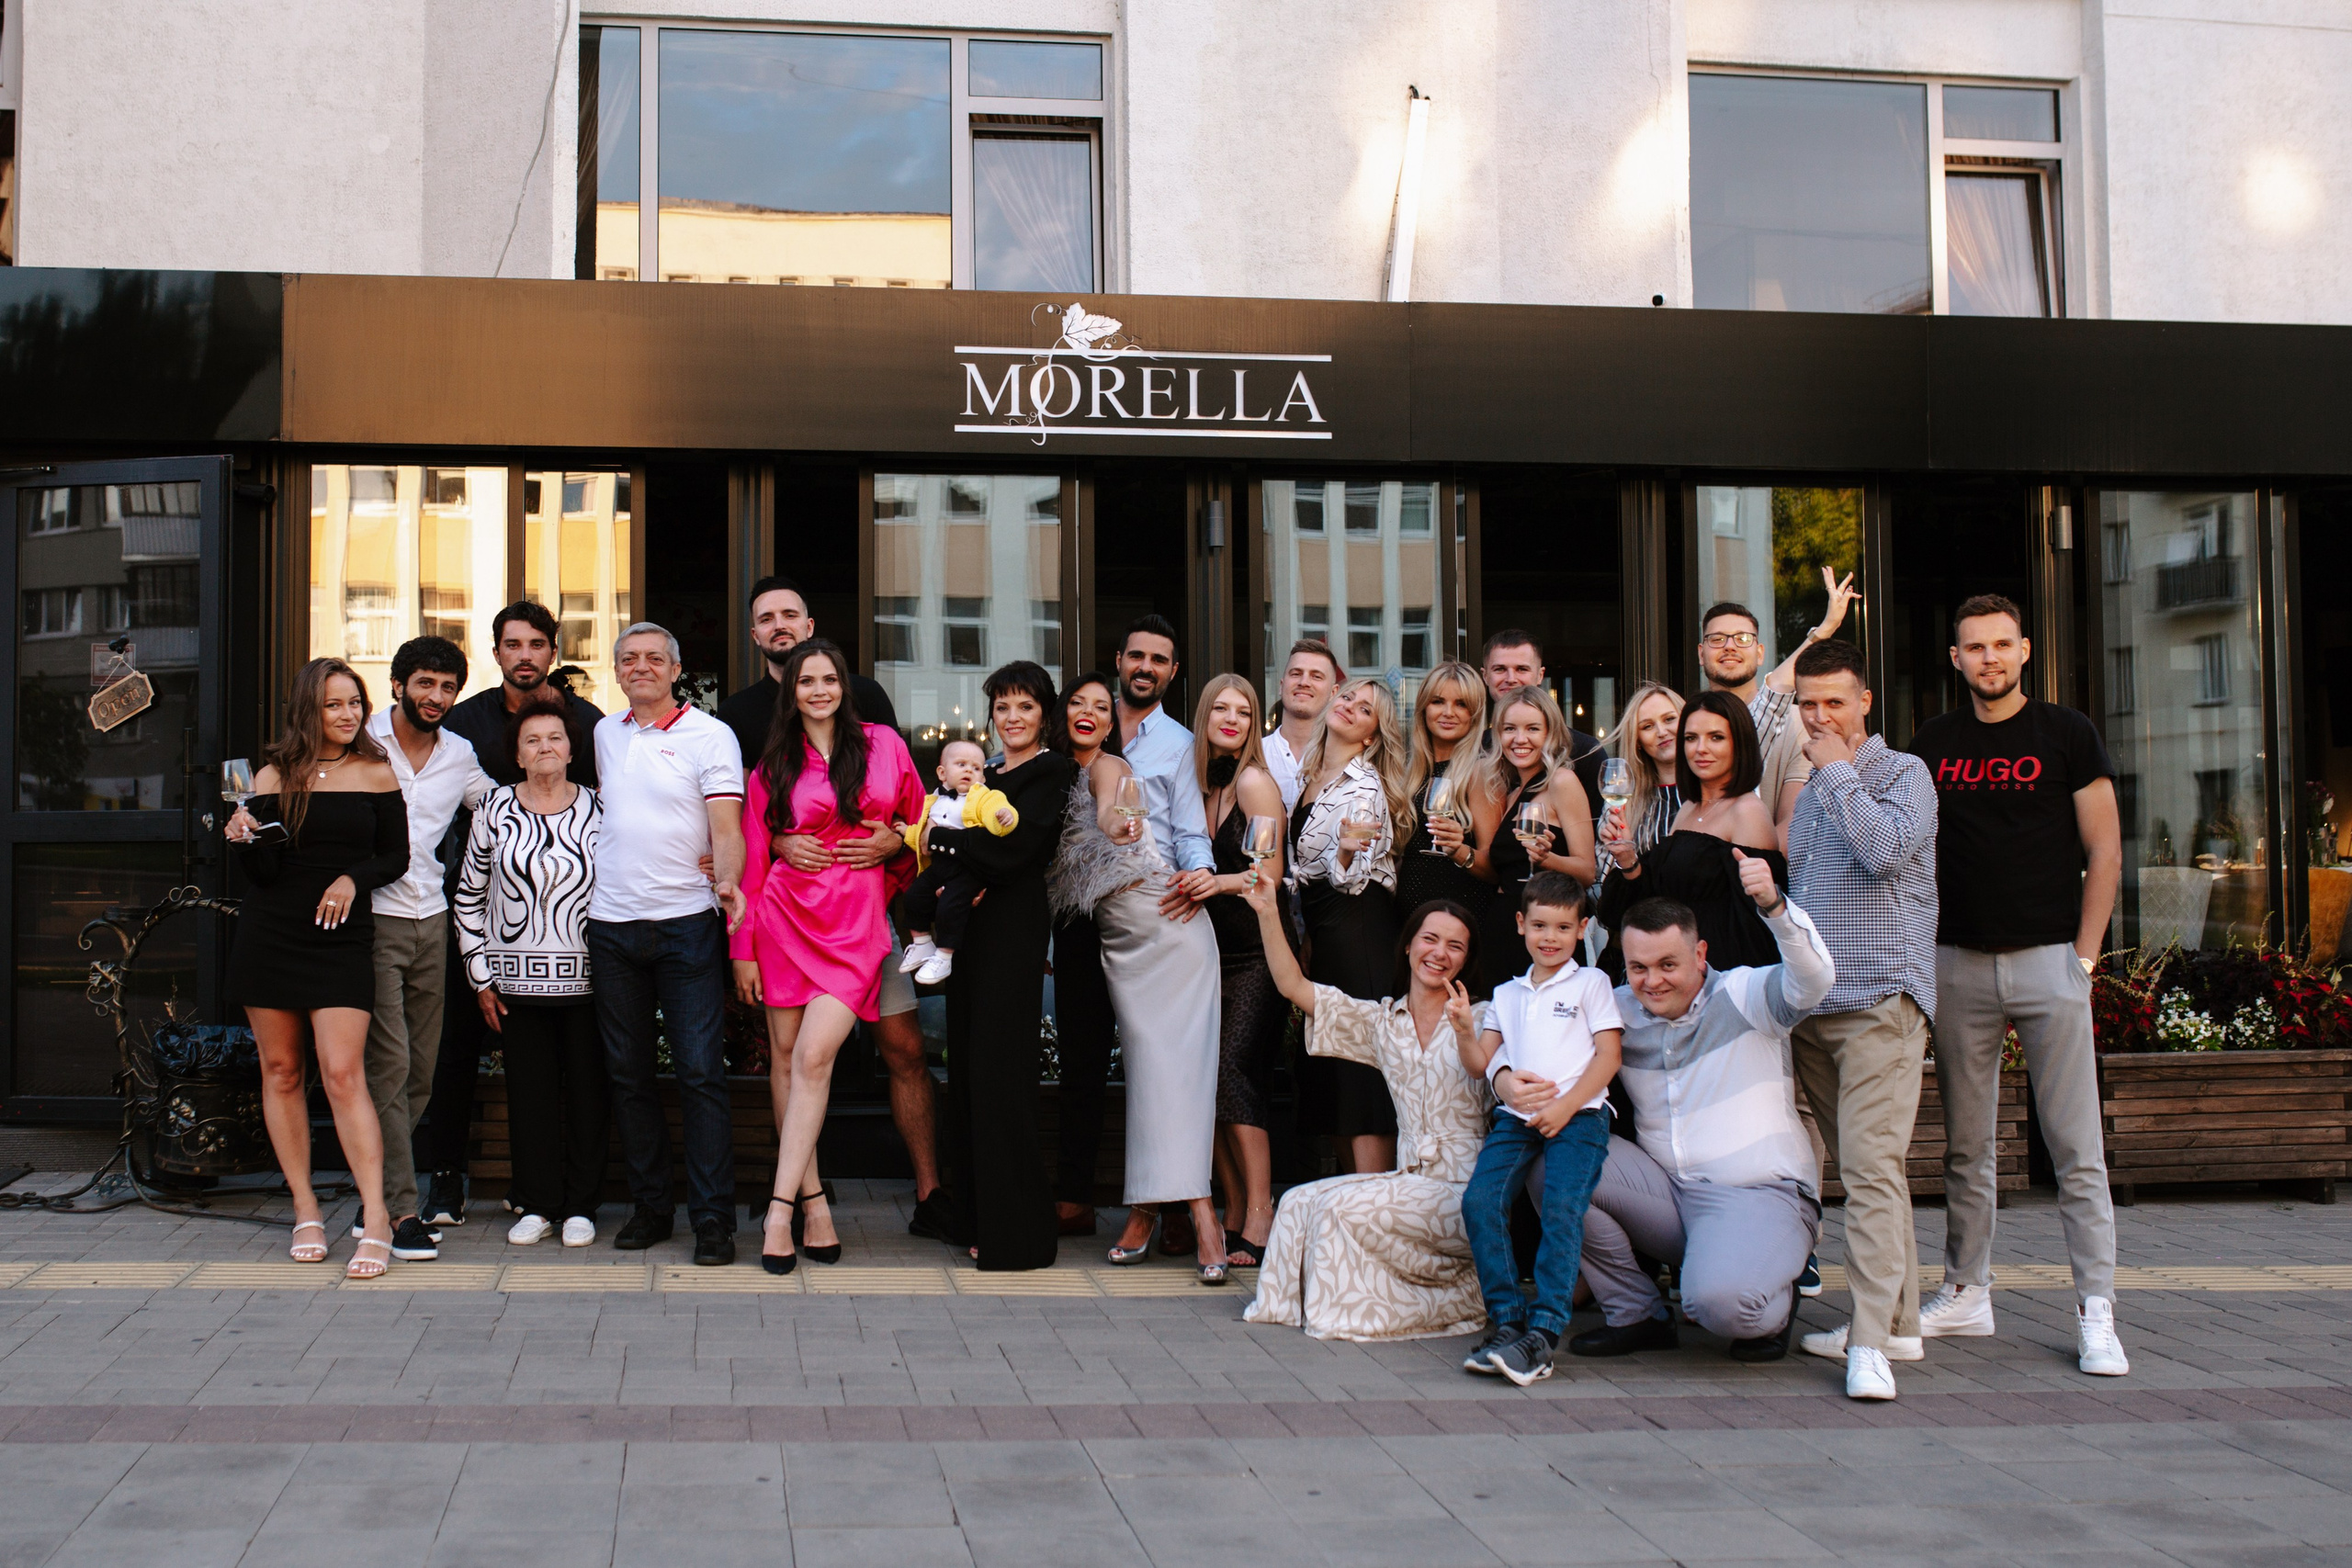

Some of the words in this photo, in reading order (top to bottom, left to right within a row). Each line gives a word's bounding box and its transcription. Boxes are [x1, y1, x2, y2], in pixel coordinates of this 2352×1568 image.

[959, 362, 1328, 423] MORELLA
[97, 688, 141, 718] Open
[1937, 756, 2041, 782] HUGO
[1989, 783, 2035, 791] BOSS
